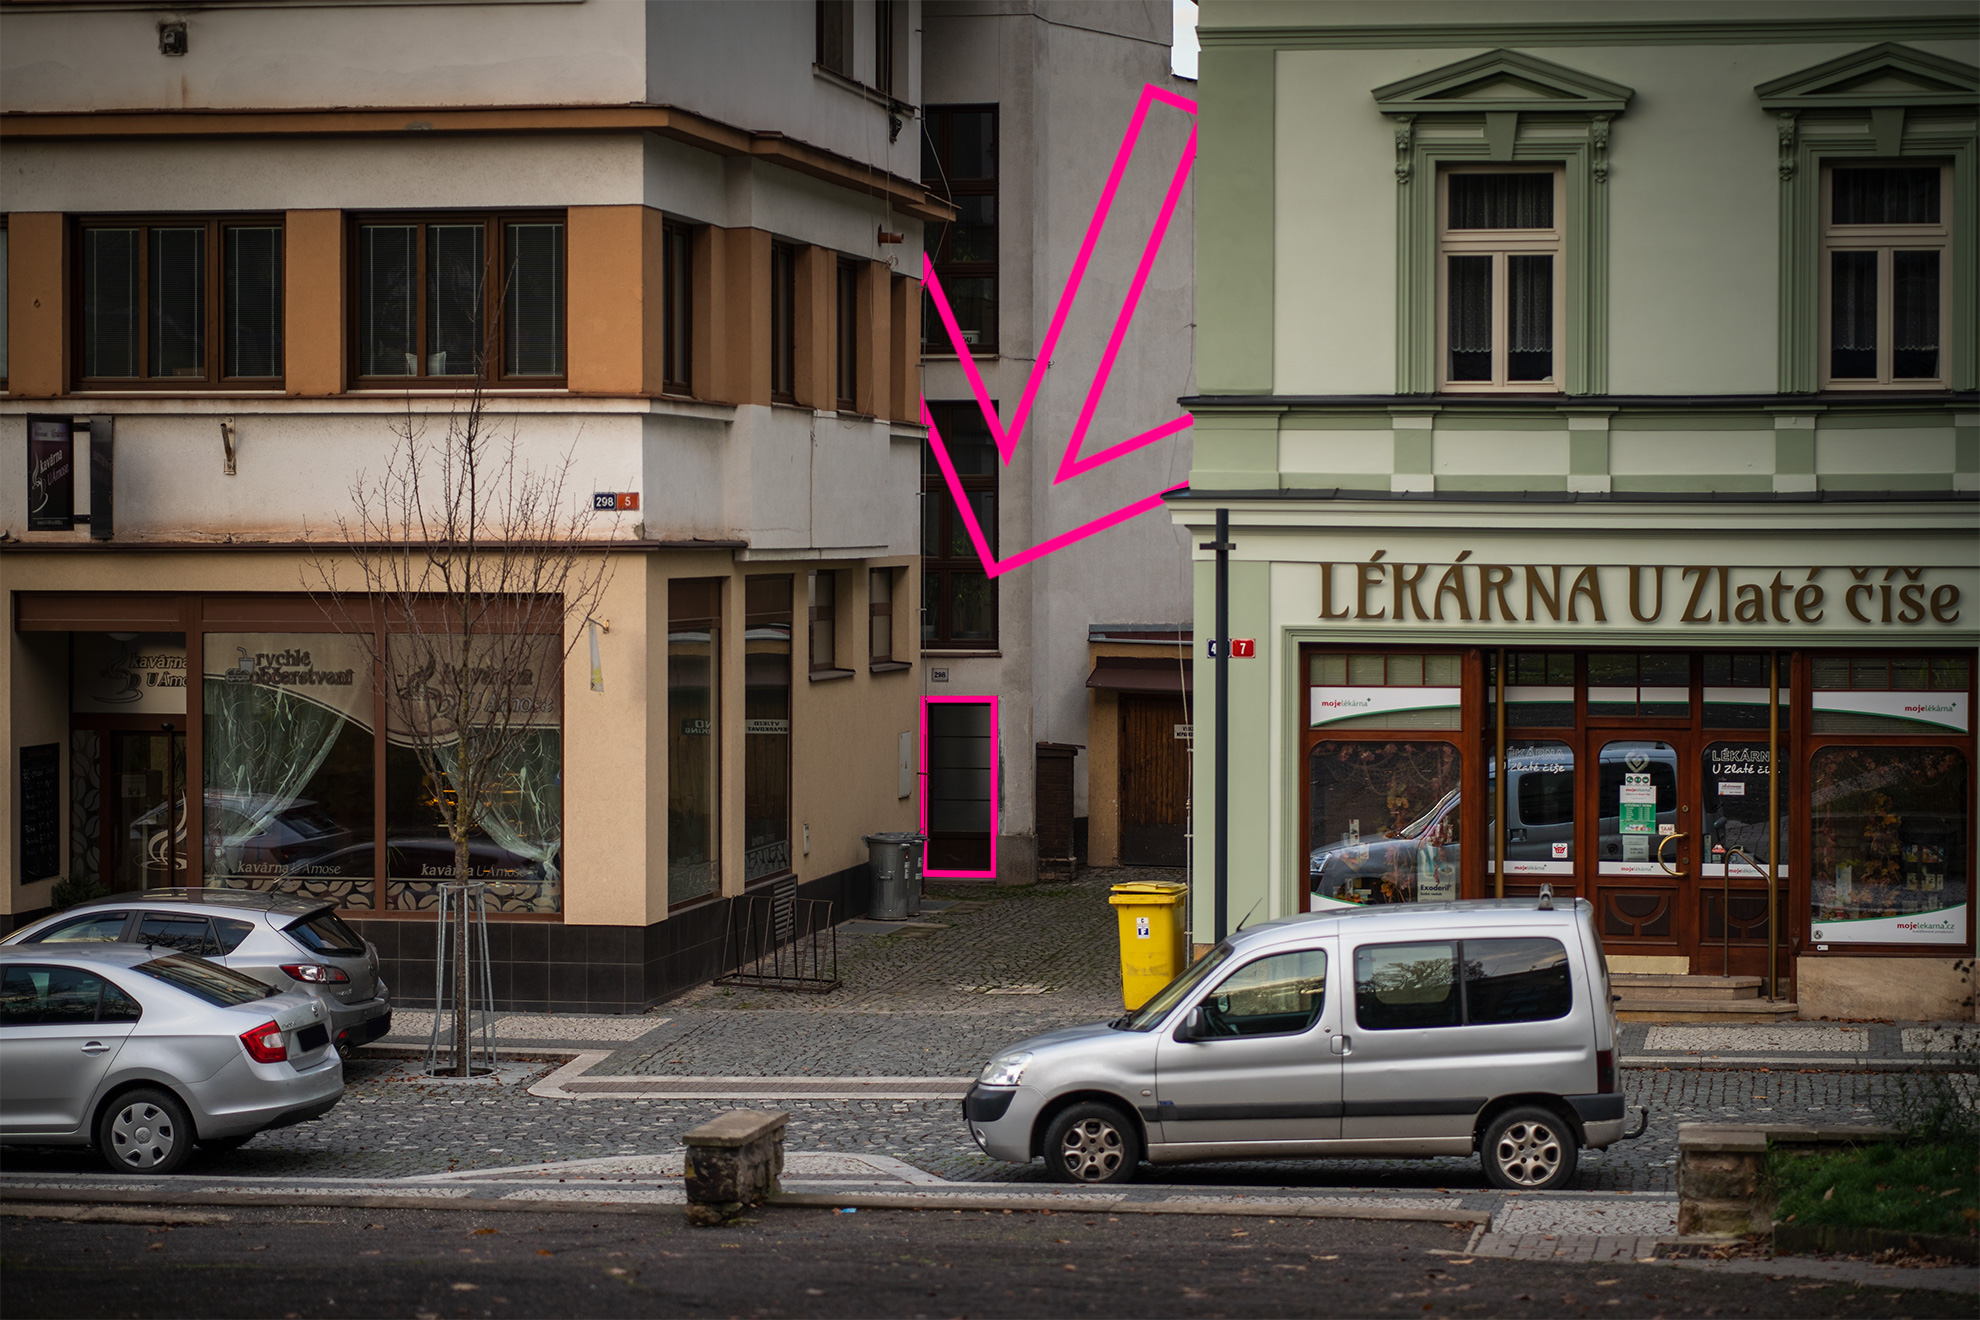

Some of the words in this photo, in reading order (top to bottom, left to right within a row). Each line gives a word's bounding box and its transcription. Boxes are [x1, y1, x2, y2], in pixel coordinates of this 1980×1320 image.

[39, 449, 63, 474] kavárna
[596, 496, 614, 507] 298
[624, 496, 631, 506] 5
[1318, 550, 1607, 623] LÉKÁRNA
[1628, 566, 1665, 622] U
[1680, 566, 1824, 623] Zlaté
[1845, 566, 1960, 623] číše
[1239, 643, 1246, 655] 7
[255, 648, 312, 668] rychlé
[146, 672, 159, 687] U
[157, 671, 186, 687] Ámo
[249, 665, 355, 685] občerstvení
[934, 671, 946, 679] 298
[1321, 699, 1368, 708] mojelékárna
[1904, 704, 1953, 713] mojelékárna
[1503, 746, 1565, 760] ÉKÁRNA
[1711, 748, 1780, 762] LÉKÁRN
[1510, 761, 1539, 772] Zlaté
[1542, 764, 1566, 774] číše
[1712, 763, 1721, 774] U
[1724, 763, 1755, 774] Zlaté
[237, 861, 289, 874] kavárna
[420, 863, 474, 876] kavára
[476, 865, 487, 877] U
[1896, 921, 1955, 930] mojelekarna.cz
